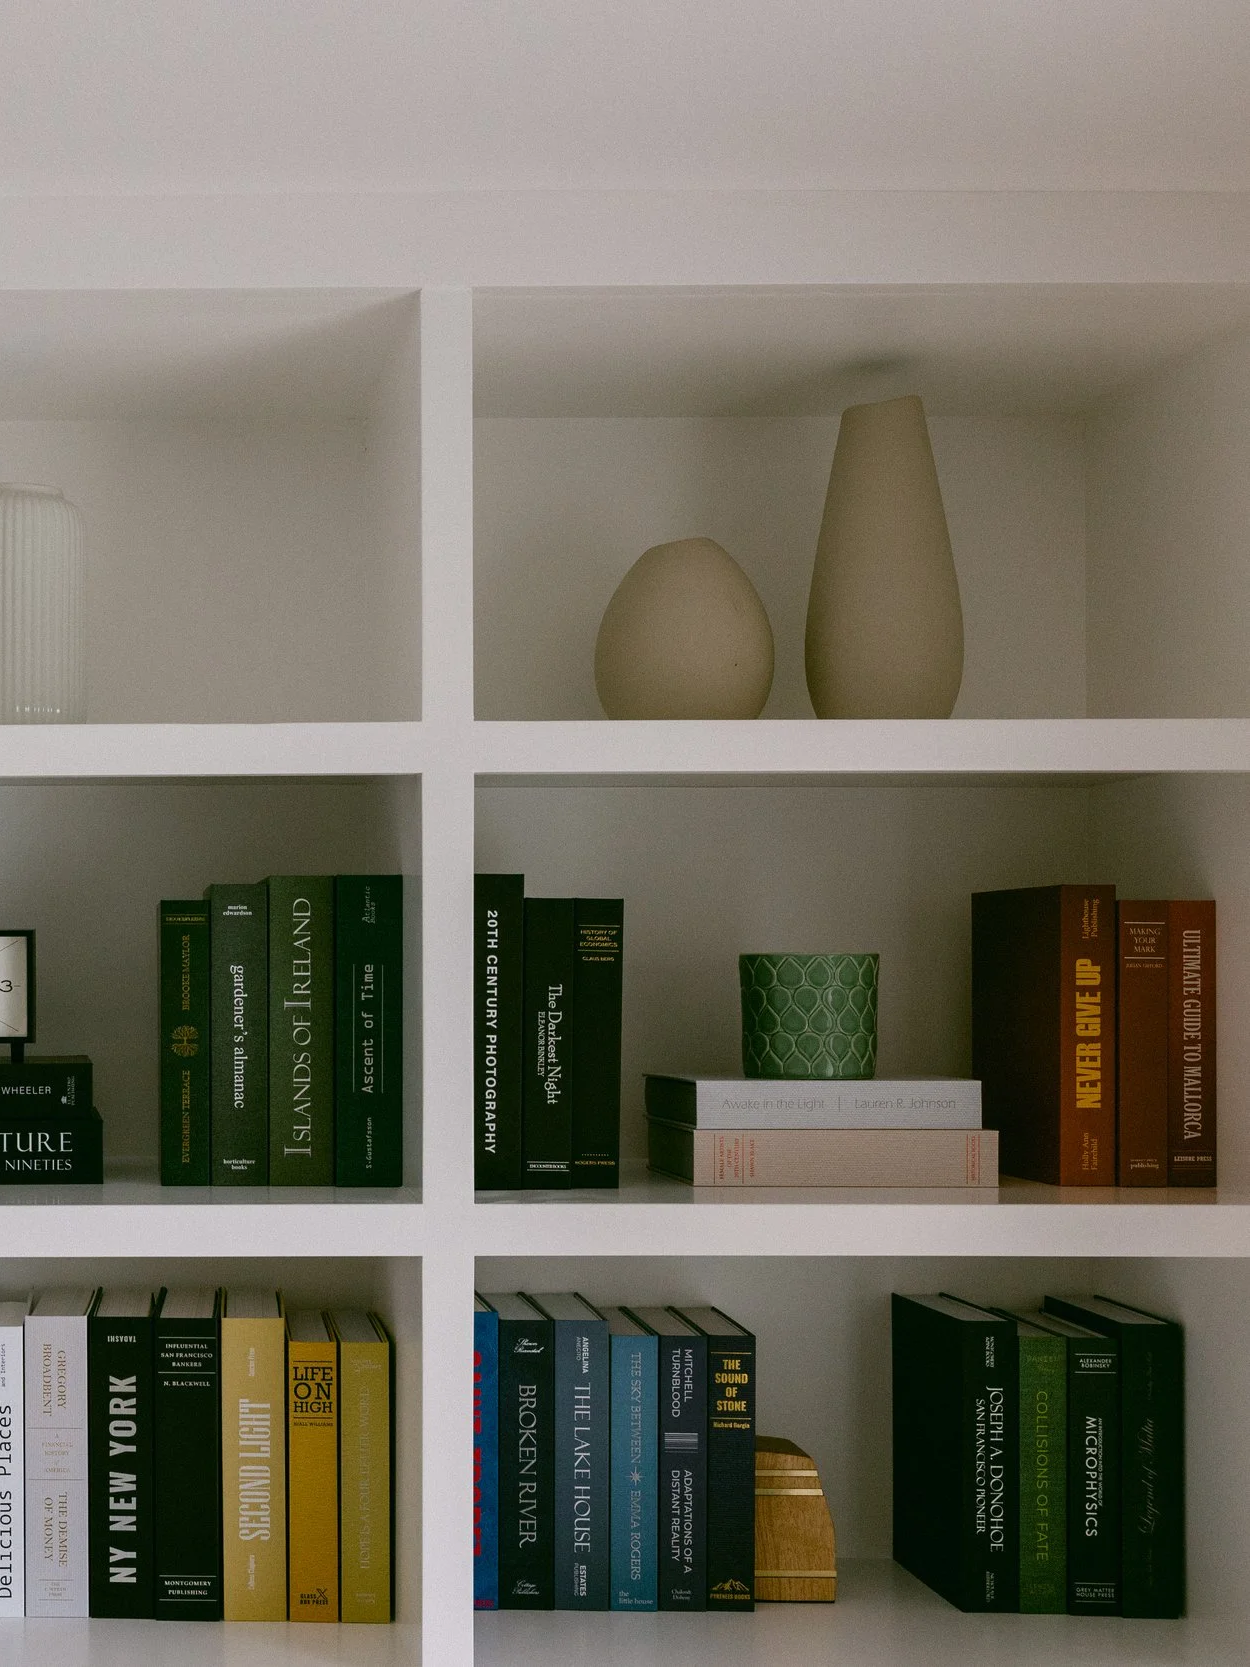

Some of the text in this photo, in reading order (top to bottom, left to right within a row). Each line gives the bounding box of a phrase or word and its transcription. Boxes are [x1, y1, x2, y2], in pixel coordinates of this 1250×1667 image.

[0, 980, 13, 992] 3
[230, 965, 248, 1108] gardener's almanac
[284, 898, 311, 1156] ISLANDS OF IRELAND
[361, 964, 374, 1093] Ascent of Time
[485, 910, 498, 1153] 20TH CENTURY PHOTOGRAPHY
[546, 984, 563, 1104] The Darkest Night
[1075, 958, 1101, 1109] NEVER GIVE UP
[1182, 930, 1202, 1139] ULTIMATE GUIDE TO MALLORCA
[1, 1086, 51, 1095] WHEELER
[5, 1159, 72, 1171] NINETIES
[1090, 1138, 1098, 1170] Fairchild
[43, 1344, 52, 1417] BROADBENT
[57, 1350, 66, 1409] GREGORY
[293, 1366, 333, 1381] LIFE
[294, 1382, 331, 1400] ON
[671, 1348, 681, 1418] TURNBLOOD
[684, 1349, 693, 1402] MITCHELL
[715, 1373, 748, 1384] SOUND
[722, 1359, 741, 1370] THE
[725, 1387, 738, 1398] OF
[293, 1401, 333, 1414] HIGH
[717, 1400, 747, 1412] STONE
[109, 1375, 137, 1583] NY NEW YORK
[239, 1398, 271, 1541] SECOND LIGHT
[519, 1384, 537, 1548] BROKEN RIVER
[574, 1382, 591, 1552] THE LAKE HOUSE
[976, 1399, 986, 1535] SAN FRANCISCO PIONEER
[986, 1386, 1004, 1551] JOSEPH A. DONOHOE
[1036, 1389, 1048, 1561] COLLISIONS OF FATE
[1085, 1416, 1098, 1537] MICROPHYSICS
[44, 1497, 53, 1561] OF MONEY
[58, 1492, 68, 1567] THE DEMISE
